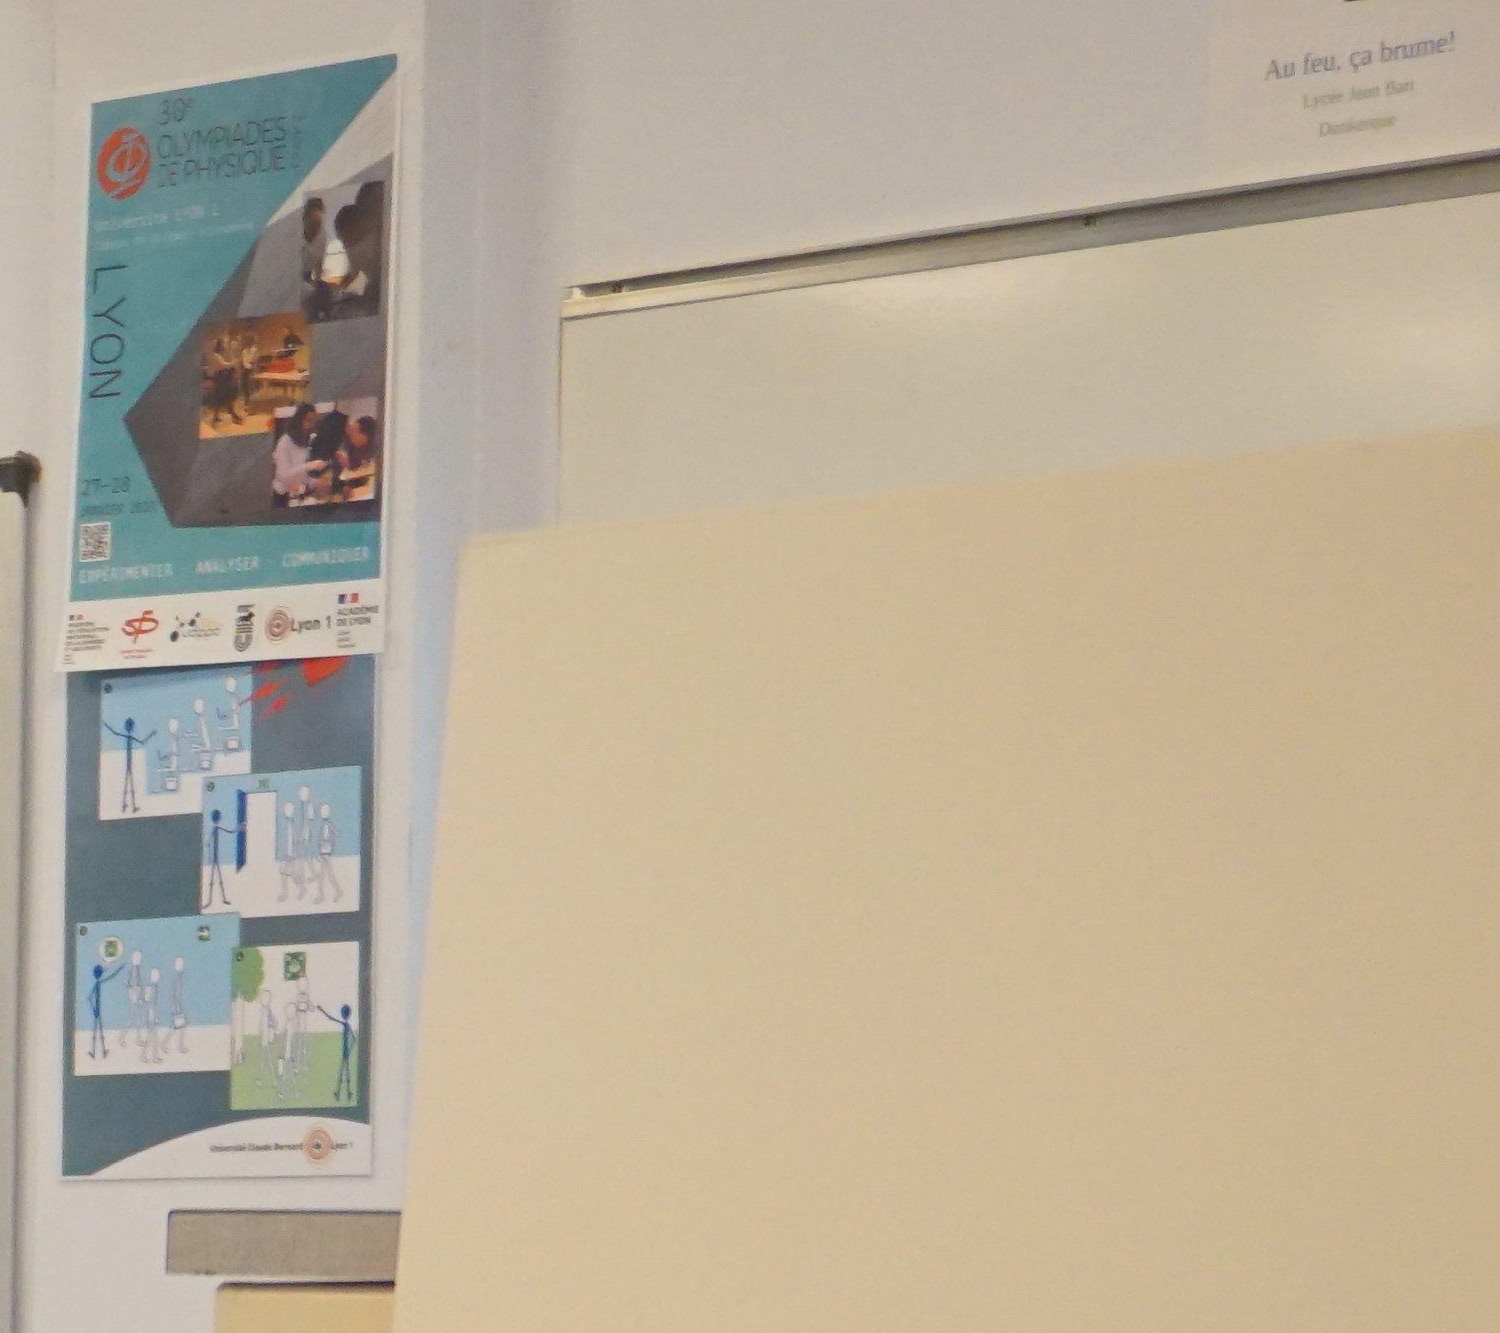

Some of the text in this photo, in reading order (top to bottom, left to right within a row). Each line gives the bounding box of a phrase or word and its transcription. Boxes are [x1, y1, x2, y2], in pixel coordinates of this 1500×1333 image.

[1265, 59, 1296, 81] Au
[1349, 48, 1372, 73] ça
[1380, 31, 1456, 62] brume!
[157, 116, 288, 160] OLYMPIADES
[183, 144, 288, 180] PHYSIQUE
[88, 264, 128, 399] LYON
[194, 556, 260, 574] ANALYSER
[290, 617, 322, 635] Lyon
